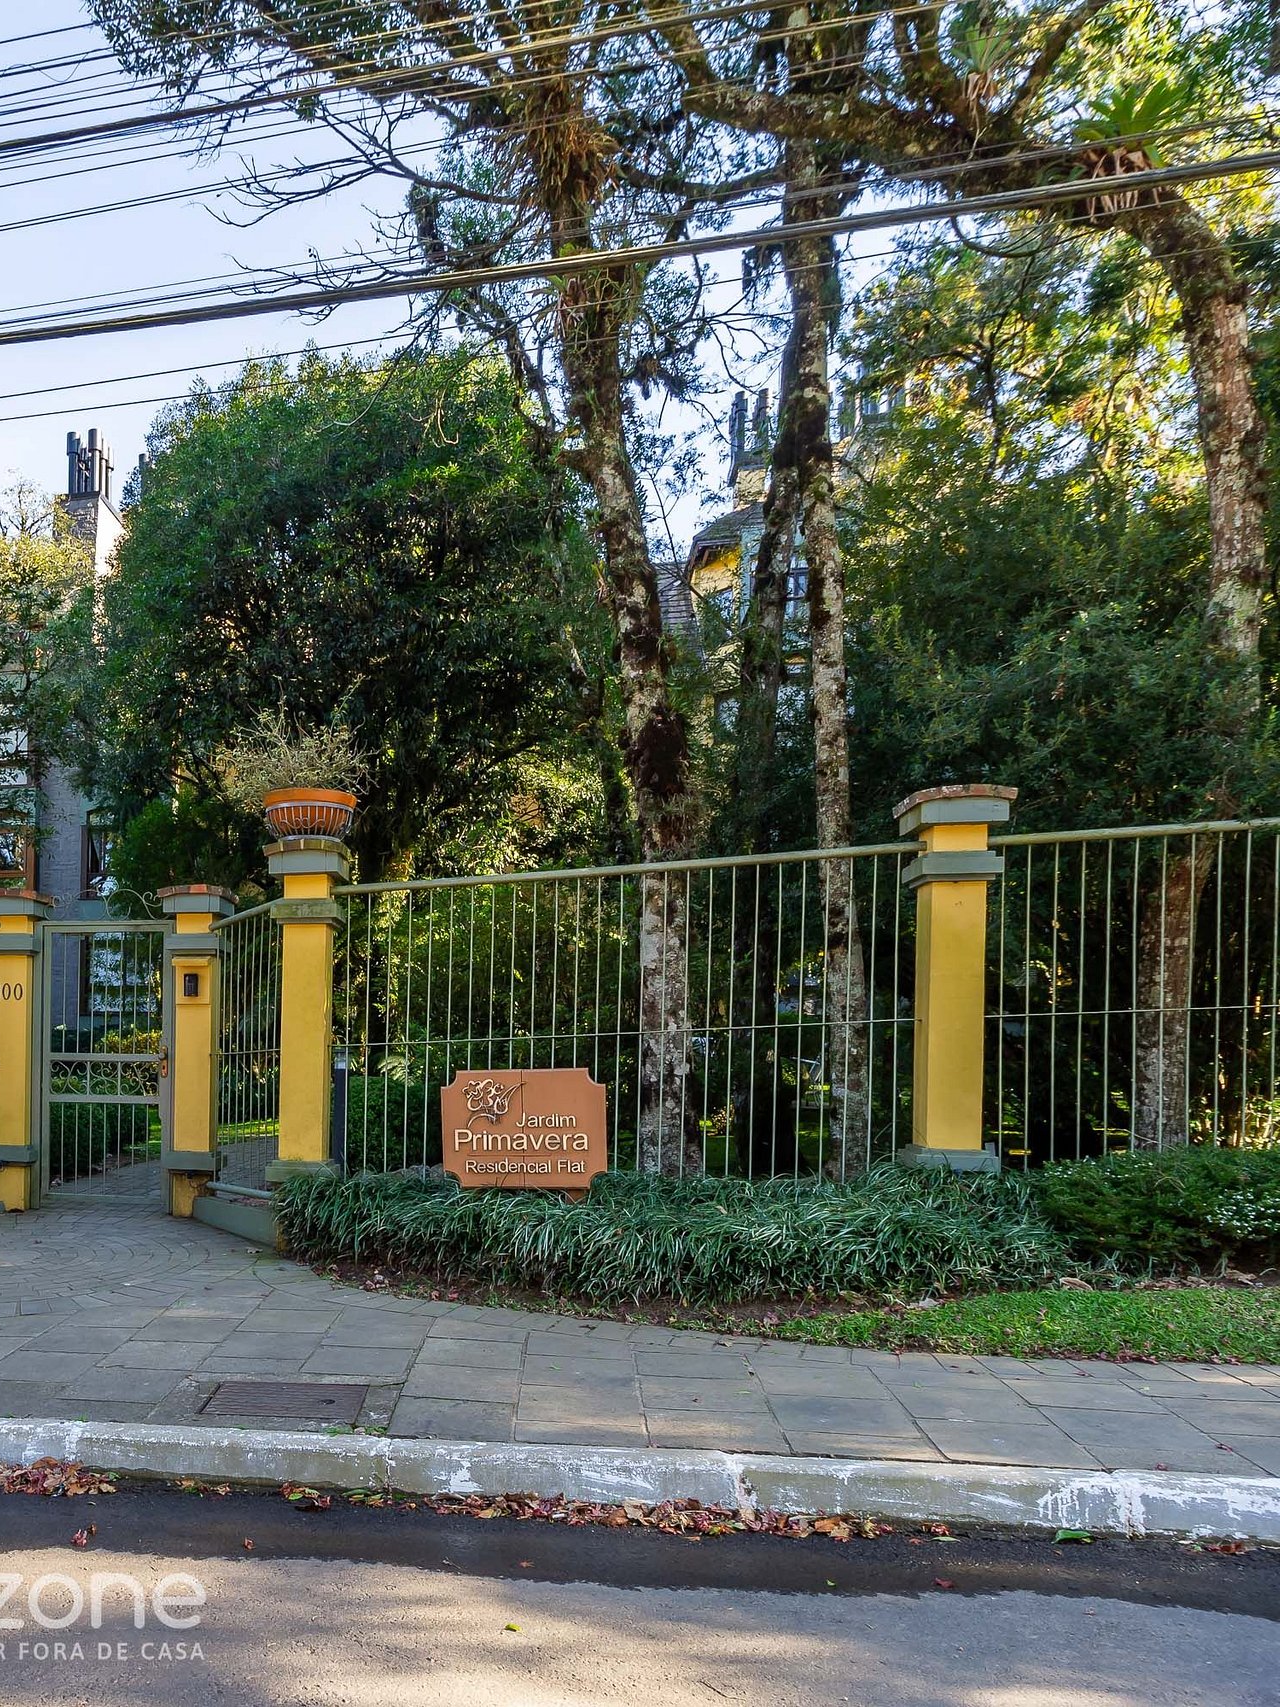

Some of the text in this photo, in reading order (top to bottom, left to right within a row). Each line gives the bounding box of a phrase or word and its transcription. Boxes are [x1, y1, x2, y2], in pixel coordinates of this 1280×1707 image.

[516, 1112, 576, 1128] Jardim
[454, 1129, 588, 1152] Primavera
[465, 1158, 586, 1174] Residencial Flat
